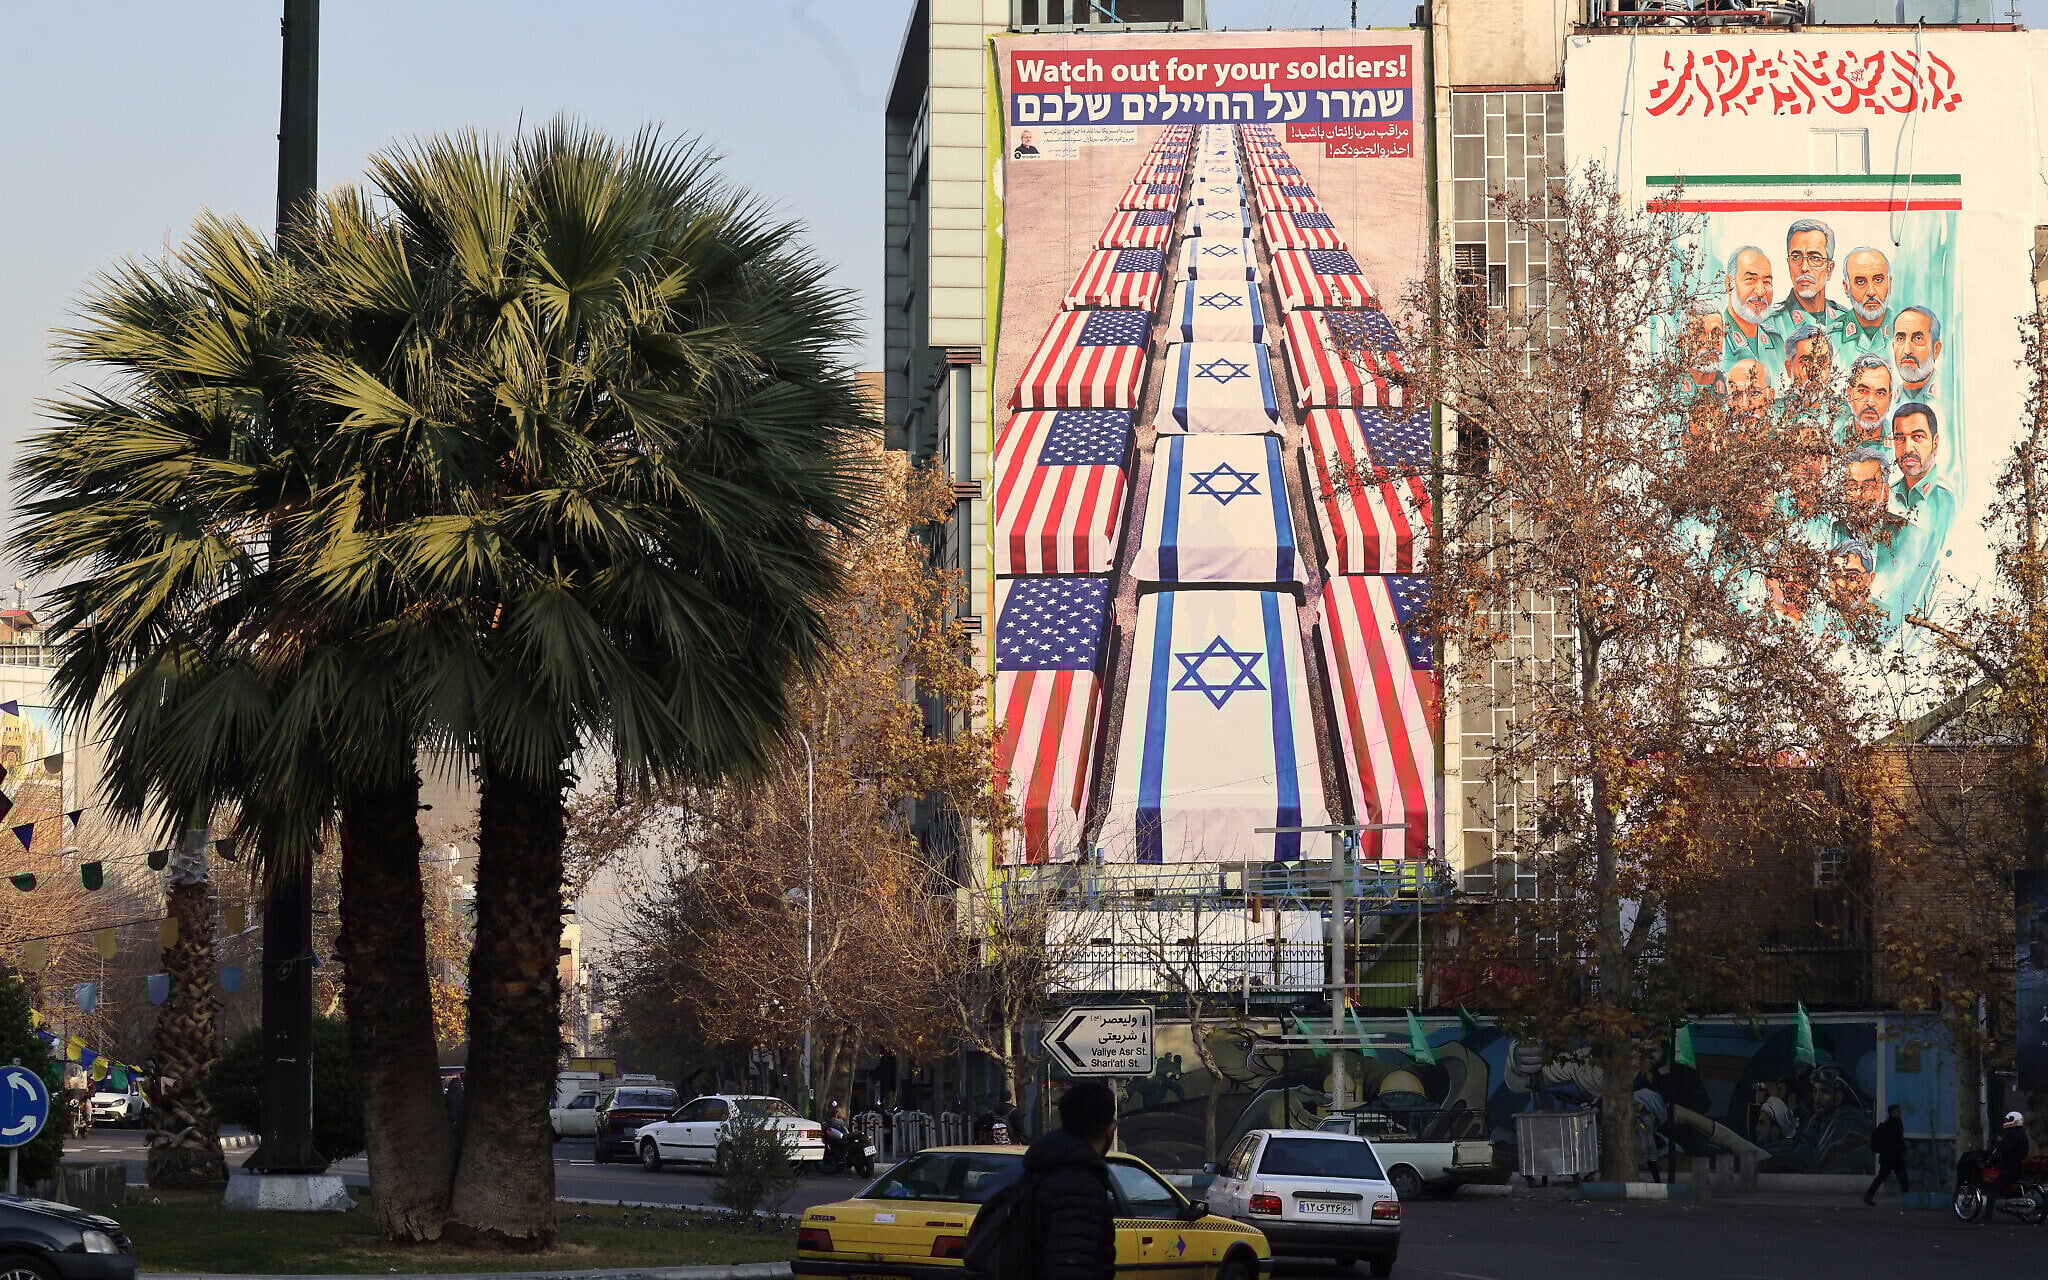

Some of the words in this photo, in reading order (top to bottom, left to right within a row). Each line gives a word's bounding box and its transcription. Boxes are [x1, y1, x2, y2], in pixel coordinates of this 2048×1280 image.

[1015, 58, 1103, 83] Watch
[1111, 60, 1160, 82] out
[1165, 56, 1208, 82] for
[1213, 61, 1280, 88] your
[1286, 54, 1407, 80] soldiers!
[1016, 84, 1112, 122] שלכם
[1120, 84, 1254, 122] החיילים
[1263, 84, 1307, 121] על
[1316, 89, 1405, 119] שמרו
[1376, 123, 1409, 140] مراقب
[1100, 1013, 1138, 1028] ولیعصر
[1098, 1030, 1138, 1045] شریعتی
[1091, 1047, 1117, 1058] Valiye
[1119, 1047, 1134, 1056] Asr
[1136, 1047, 1148, 1056] St.
[1091, 1058, 1126, 1068] Shari'ati
